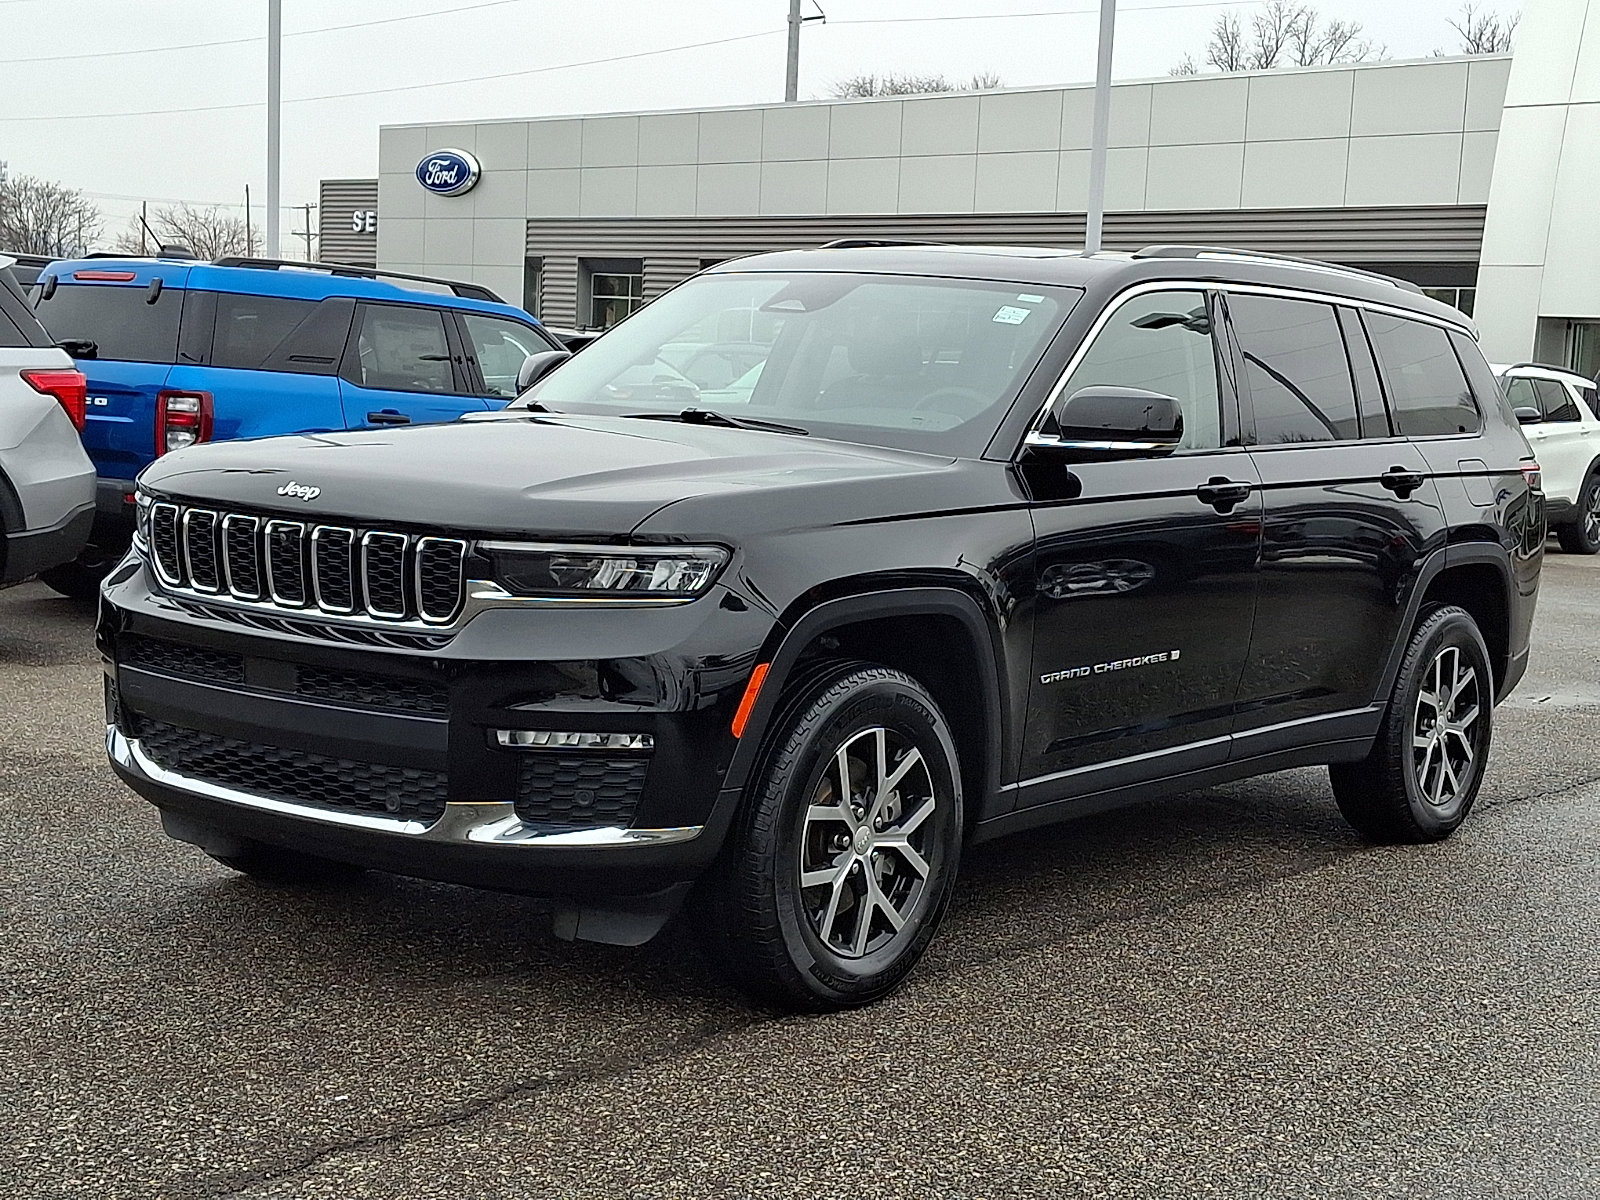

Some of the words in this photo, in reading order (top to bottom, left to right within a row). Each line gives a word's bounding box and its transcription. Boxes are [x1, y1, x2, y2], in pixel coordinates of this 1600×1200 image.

[425, 159, 459, 185] Ford
[277, 480, 321, 501] Jeep
[1040, 666, 1091, 684] GRAND
[1093, 652, 1169, 674] CHEROKEE
